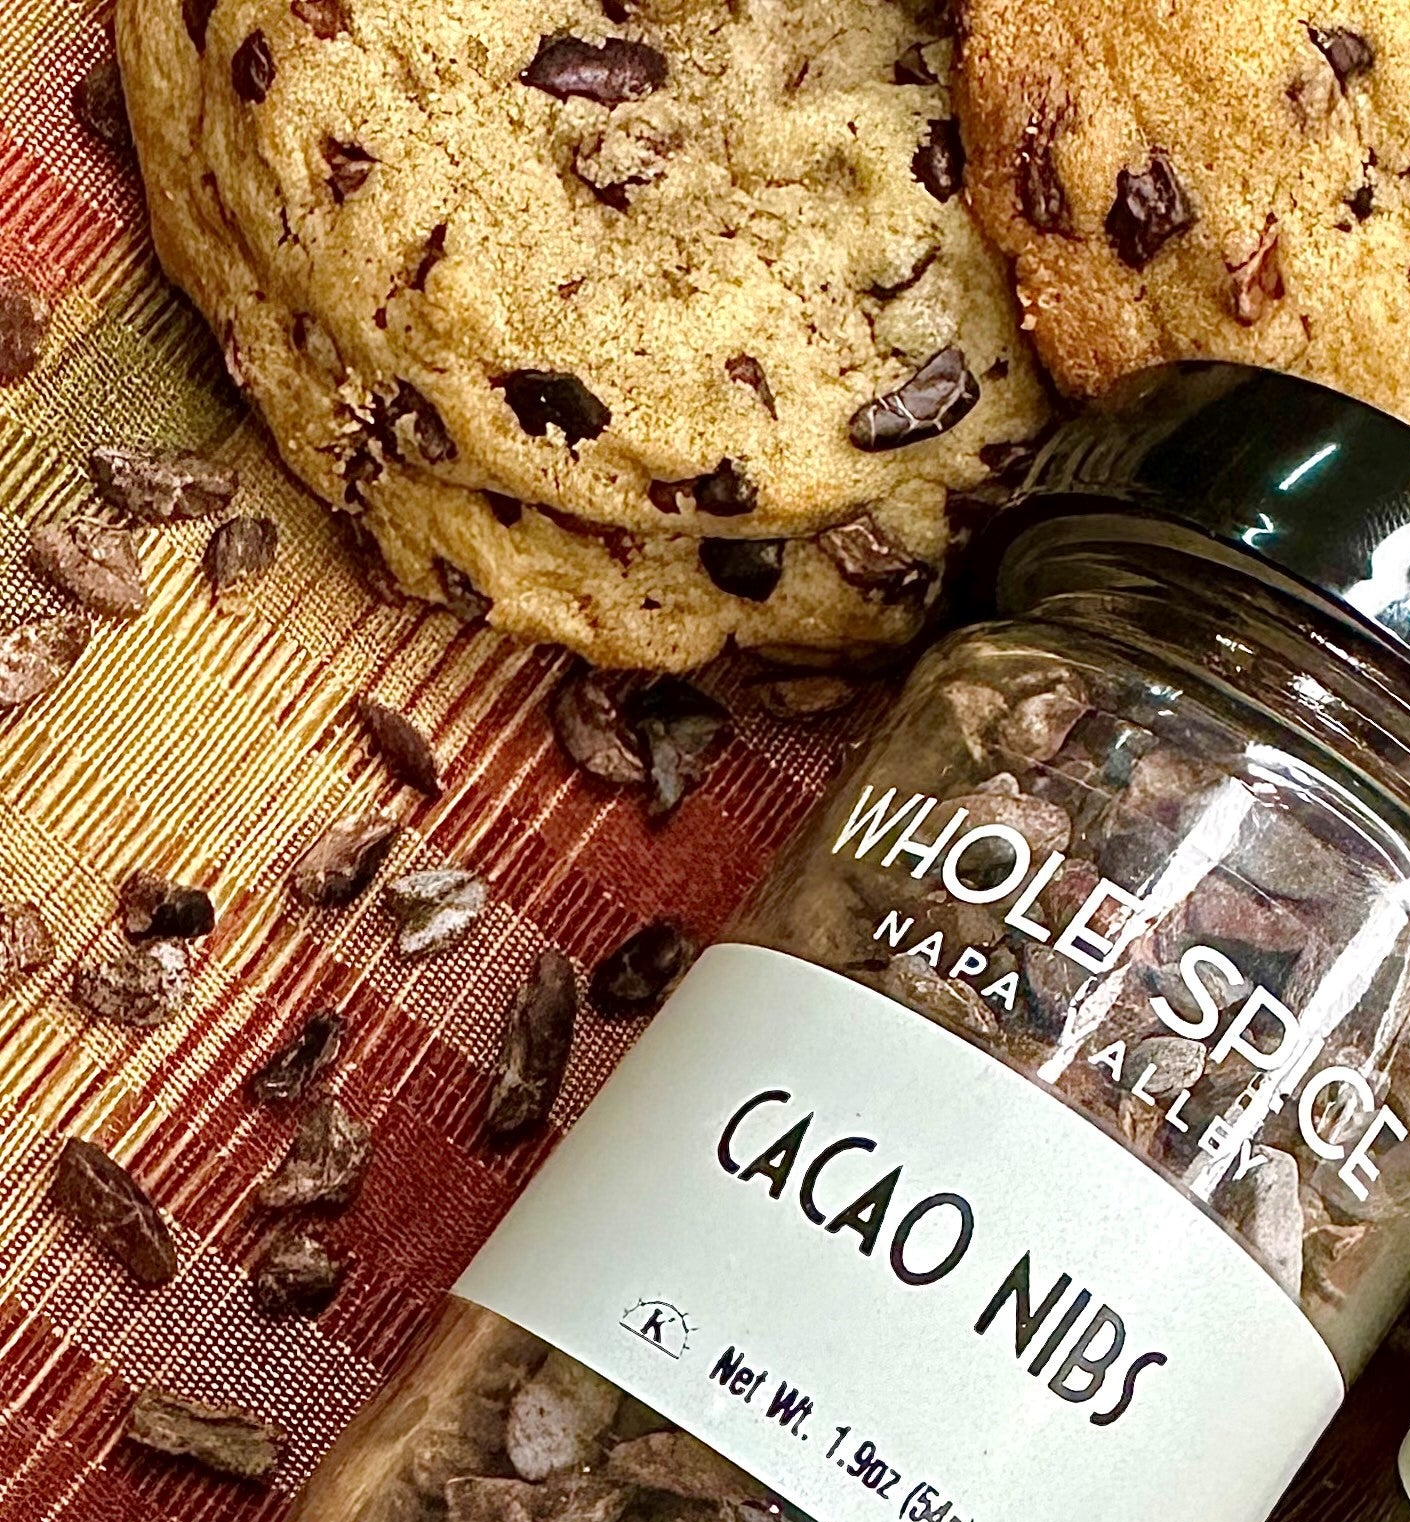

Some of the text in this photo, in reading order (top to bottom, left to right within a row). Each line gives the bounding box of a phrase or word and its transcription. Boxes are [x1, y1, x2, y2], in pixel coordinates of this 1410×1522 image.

[832, 785, 1140, 975] WHOLE
[873, 910, 1020, 1011] NAPA
[717, 1089, 1167, 1426] CACAO NIBS
[709, 1345, 768, 1403] Net
[766, 1381, 813, 1440] Wt.
[826, 1426, 901, 1499] 1.9oz
